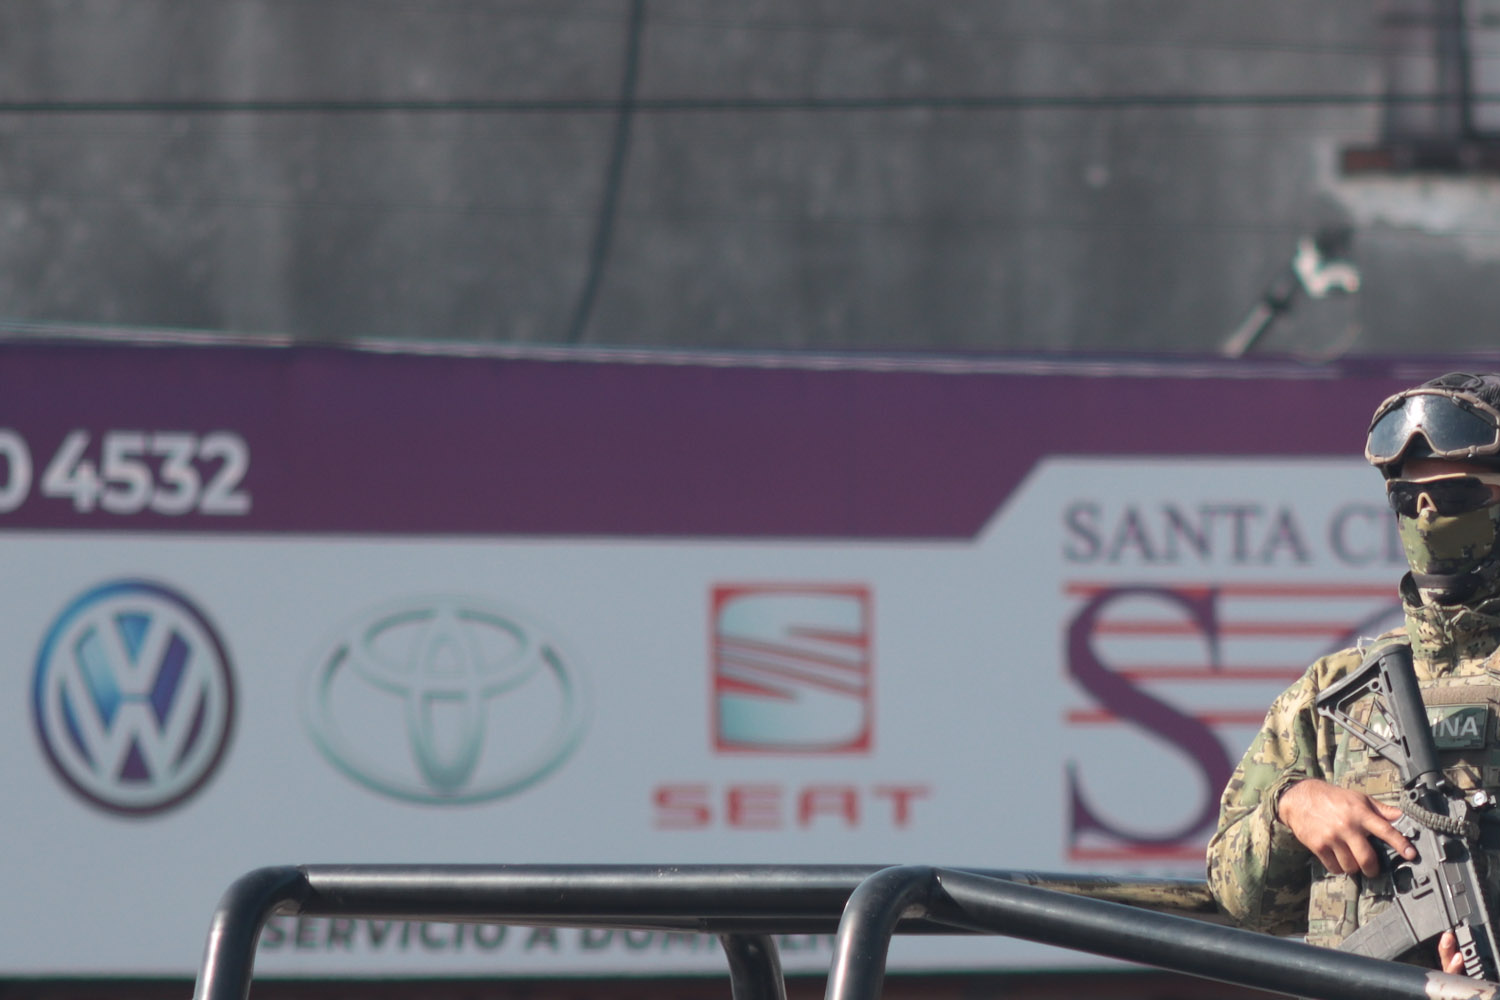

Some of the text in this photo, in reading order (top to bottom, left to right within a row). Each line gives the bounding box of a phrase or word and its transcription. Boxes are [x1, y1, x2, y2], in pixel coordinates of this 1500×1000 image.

[40, 428, 253, 517] 4532
[1063, 502, 1314, 567] SANTA
[652, 784, 933, 831] SEAT
[261, 915, 508, 950] SERVICIO
